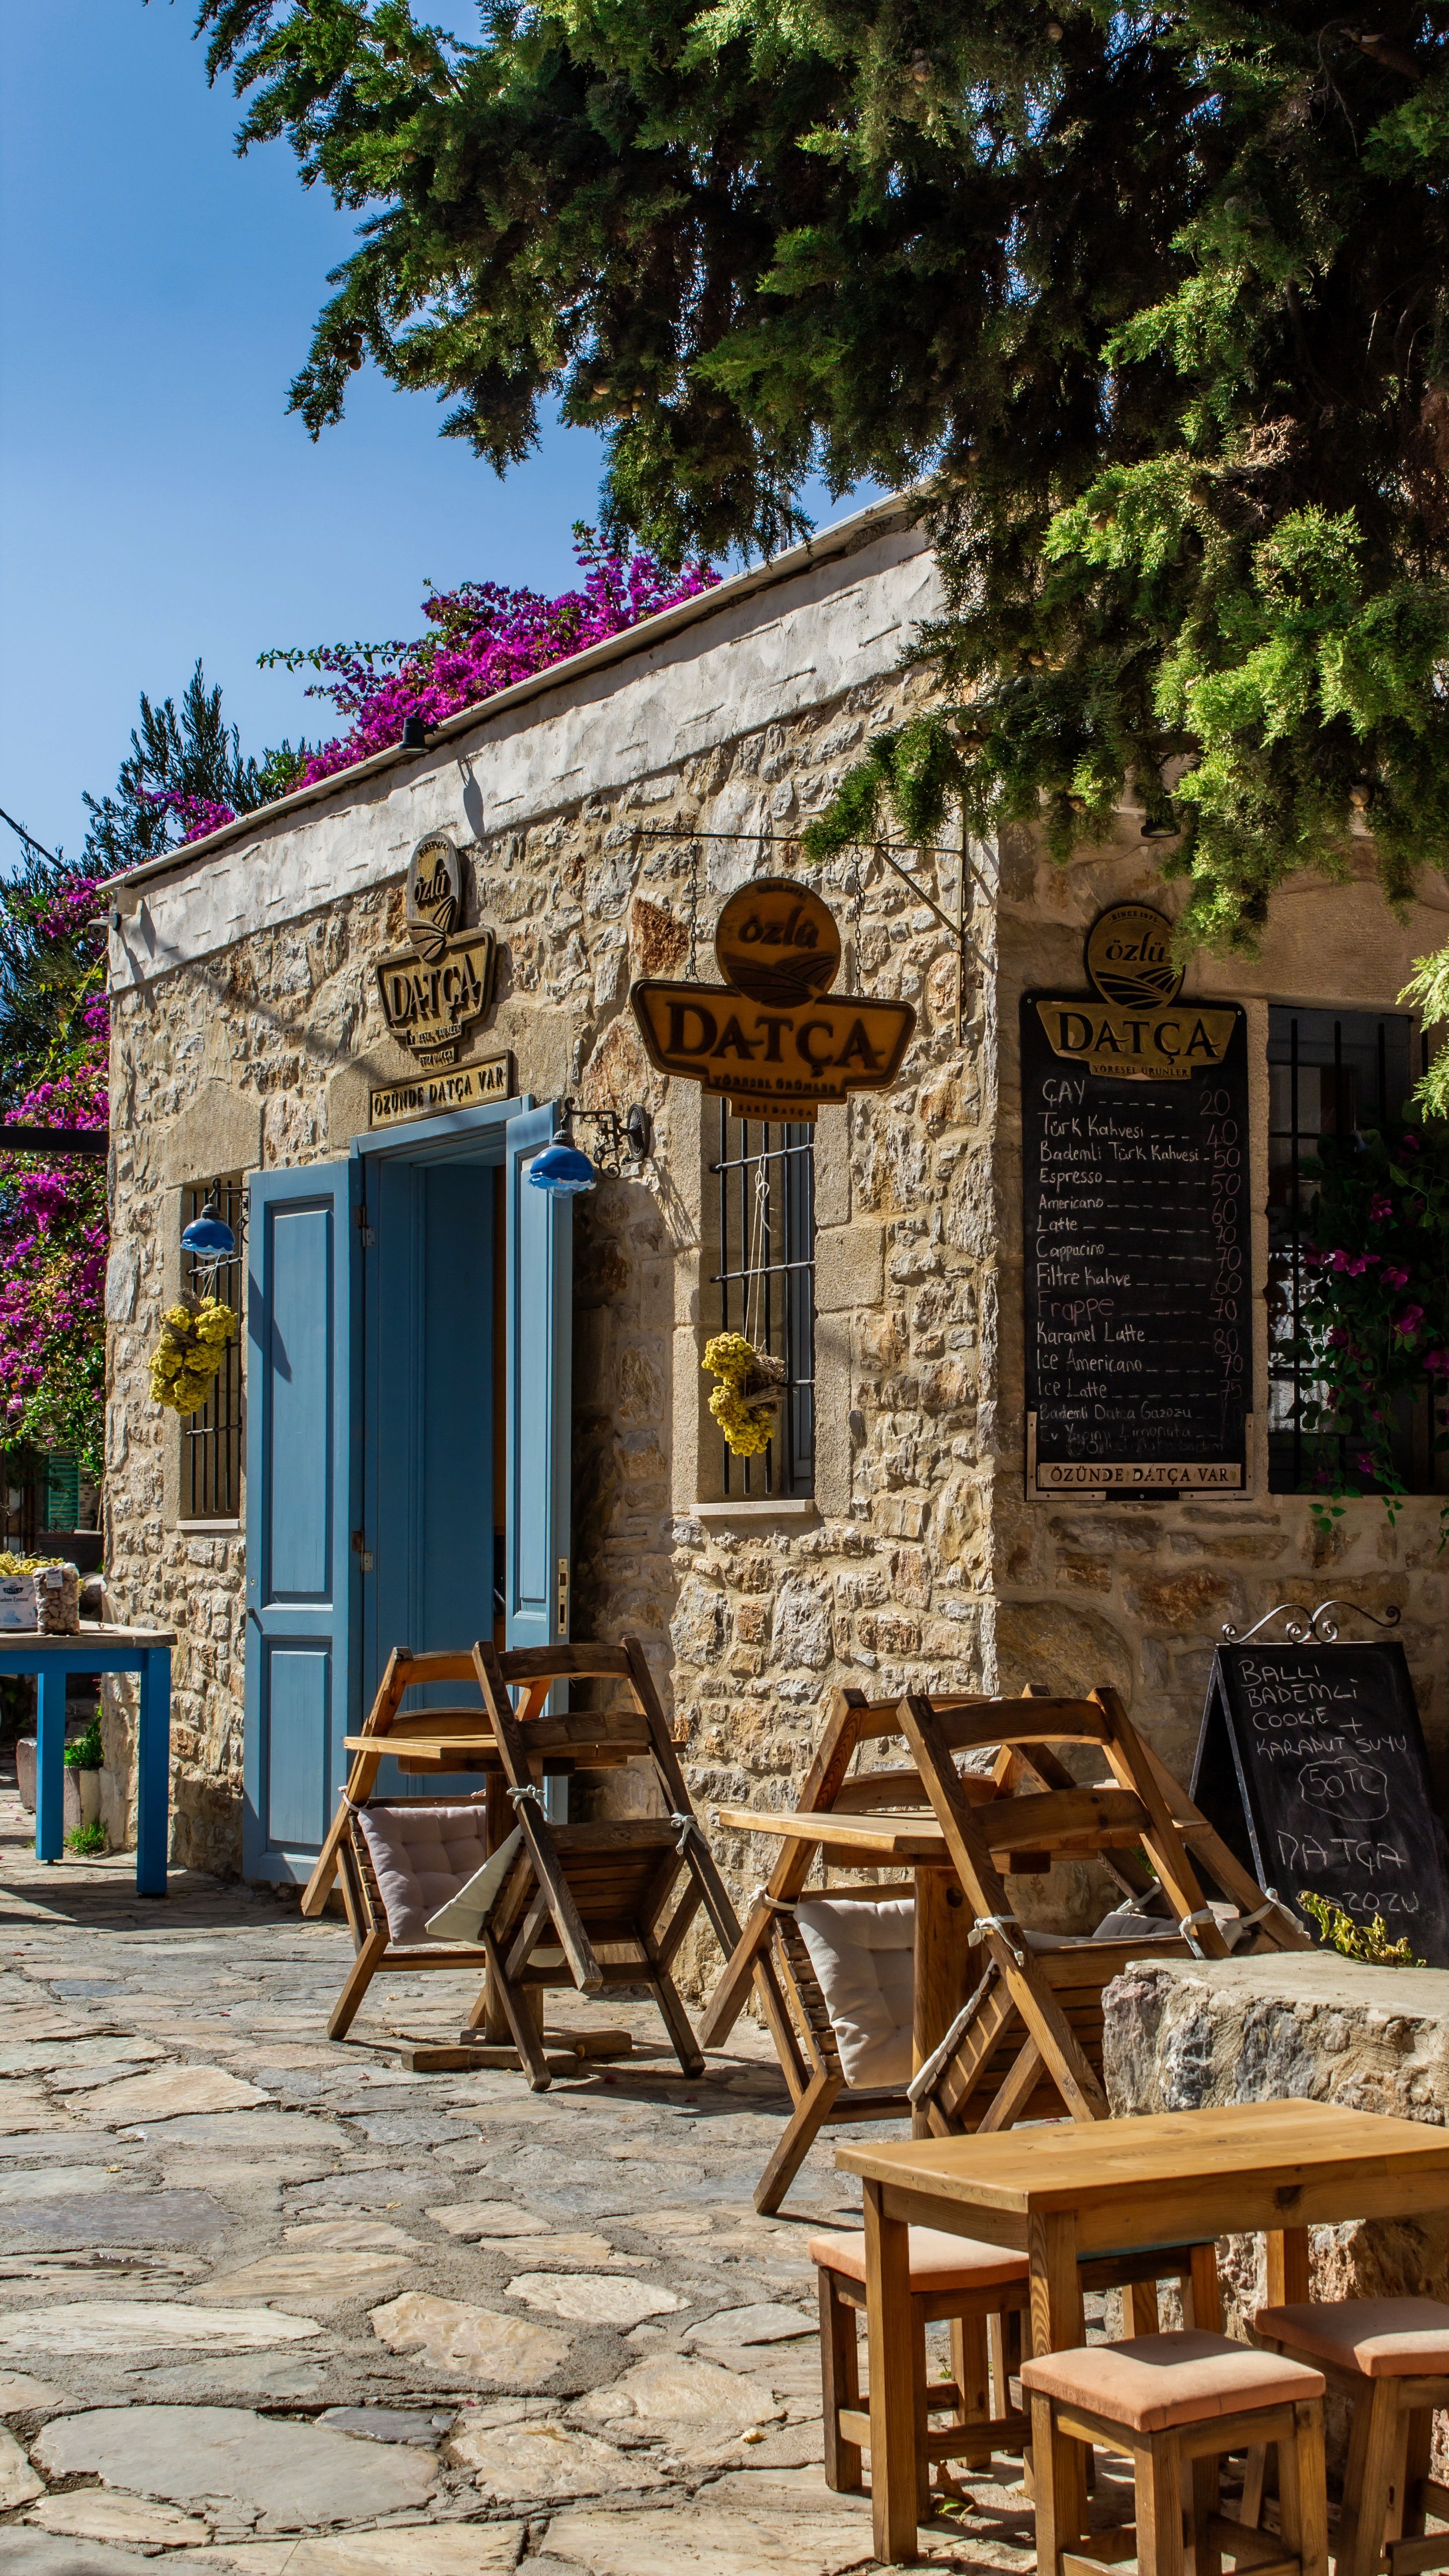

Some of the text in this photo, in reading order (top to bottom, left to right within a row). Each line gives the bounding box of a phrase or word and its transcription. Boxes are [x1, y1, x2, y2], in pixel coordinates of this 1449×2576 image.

[1106, 930, 1165, 962] özlü
[389, 953, 479, 1021] DATÇA
[665, 1002, 885, 1077] DATÇA
[1056, 1012, 1221, 1064] DATÇA
[1093, 1063, 1189, 1077] YÖRESEL ÜRÜNLER
[374, 1066, 503, 1115] ÖZÜNDE DATÇA VAR
[1043, 1079, 1230, 1116] ÇAY 20
[1038, 1112, 1237, 1148] Türk Kahvesi 40
[1041, 1140, 1240, 1167] Bademli Türk Kahvesi 50
[1040, 1168, 1240, 1195] Espresso 50
[1039, 1194, 1236, 1224] Americano 60
[1037, 1215, 1236, 1244] Latte 70
[1037, 1236, 1241, 1270] Cappucino 70
[1037, 1263, 1242, 1294] Filtre Kahve 60
[1038, 1291, 1237, 1327] Frappe 70
[1038, 1321, 1238, 1354] Karamel Latte 80
[1037, 1348, 1242, 1377] Ice Americano 70
[1039, 1376, 1060, 1396] Ice
[1067, 1378, 1107, 1398] Latte
[1040, 1403, 1088, 1420] Bademli
[1141, 1401, 1192, 1419] Gazozu
[1050, 1465, 1228, 1485] ÖZÜNDE DATÇA VAR
[1238, 1660, 1320, 1687] BALLI
[1245, 1679, 1358, 1707] BADEMLİ
[1257, 1734, 1406, 1761] KARADUT SUYU
[1277, 1830, 1407, 1875] DATÇA
